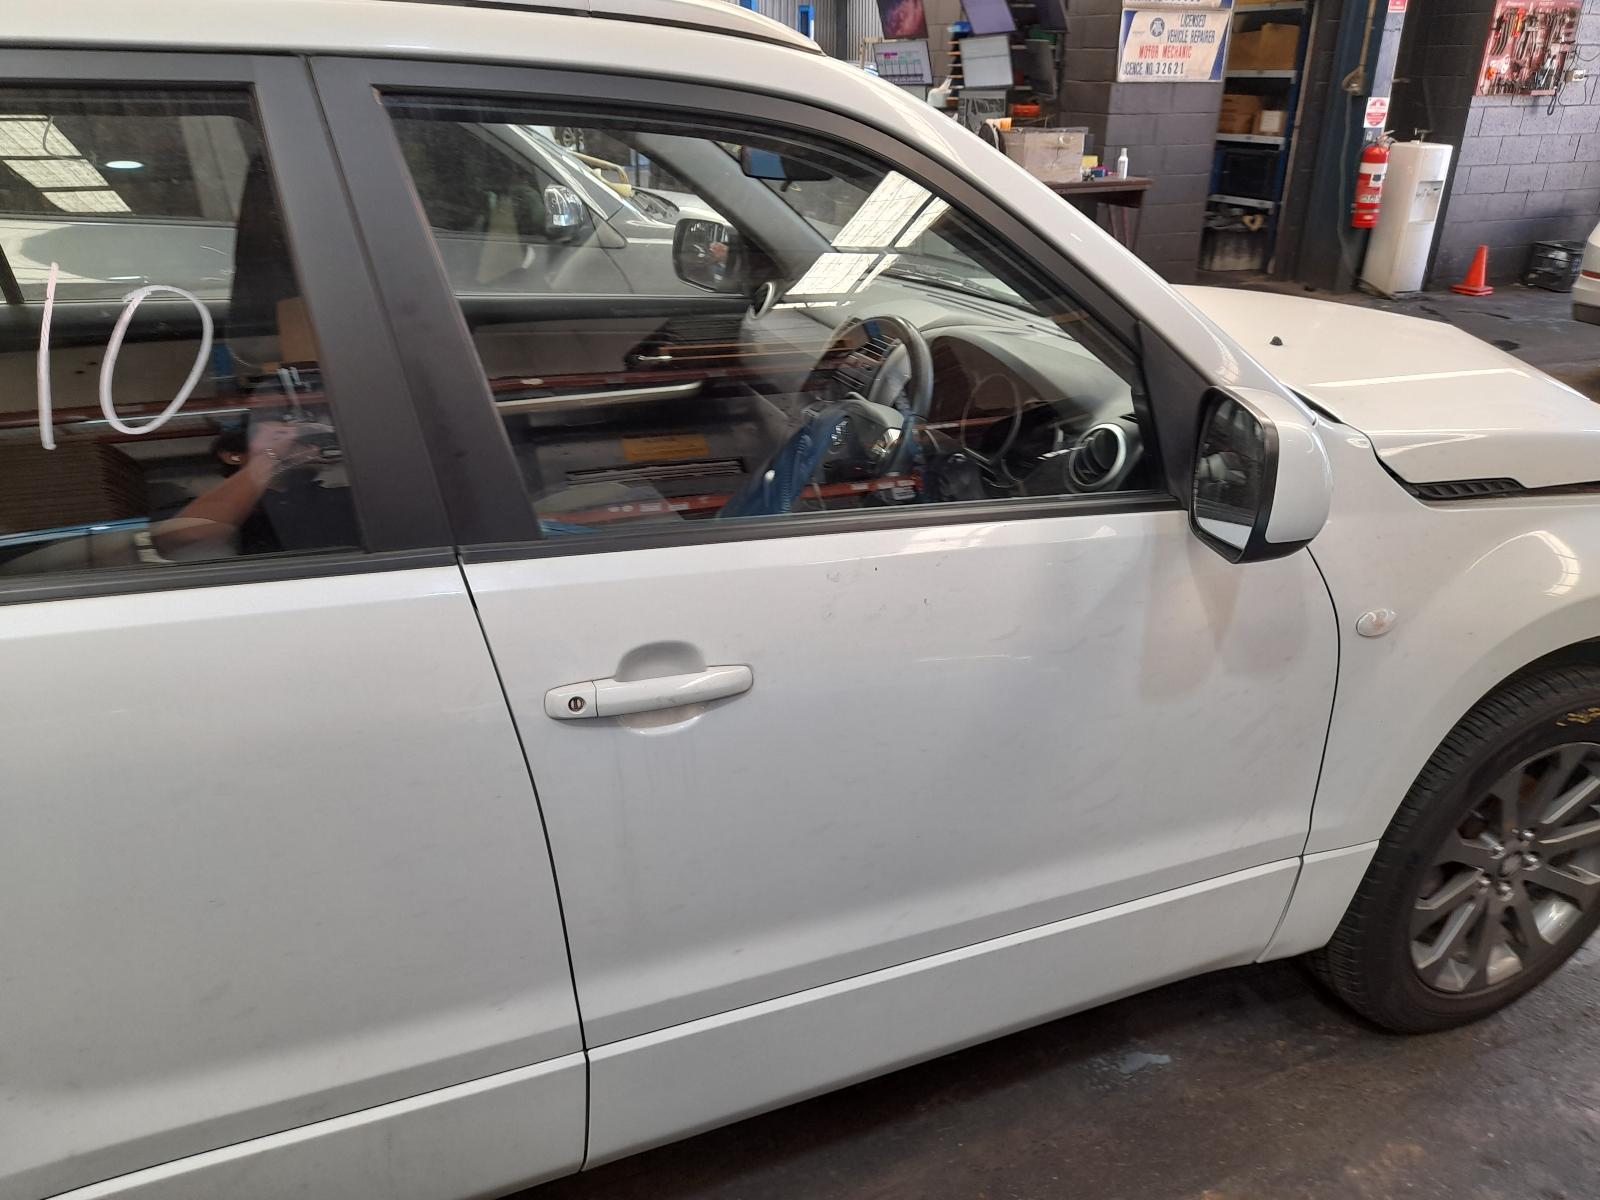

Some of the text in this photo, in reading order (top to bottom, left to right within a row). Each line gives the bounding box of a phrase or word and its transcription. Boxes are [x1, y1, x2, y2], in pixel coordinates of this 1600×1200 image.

[1180, 14, 1207, 27] LICENSED
[1167, 29, 1215, 43] VEHICLE REPAIRER
[1139, 45, 1193, 59] MOTOR MECHANIC
[1155, 62, 1184, 75] 32621
[36, 261, 214, 451] 10
